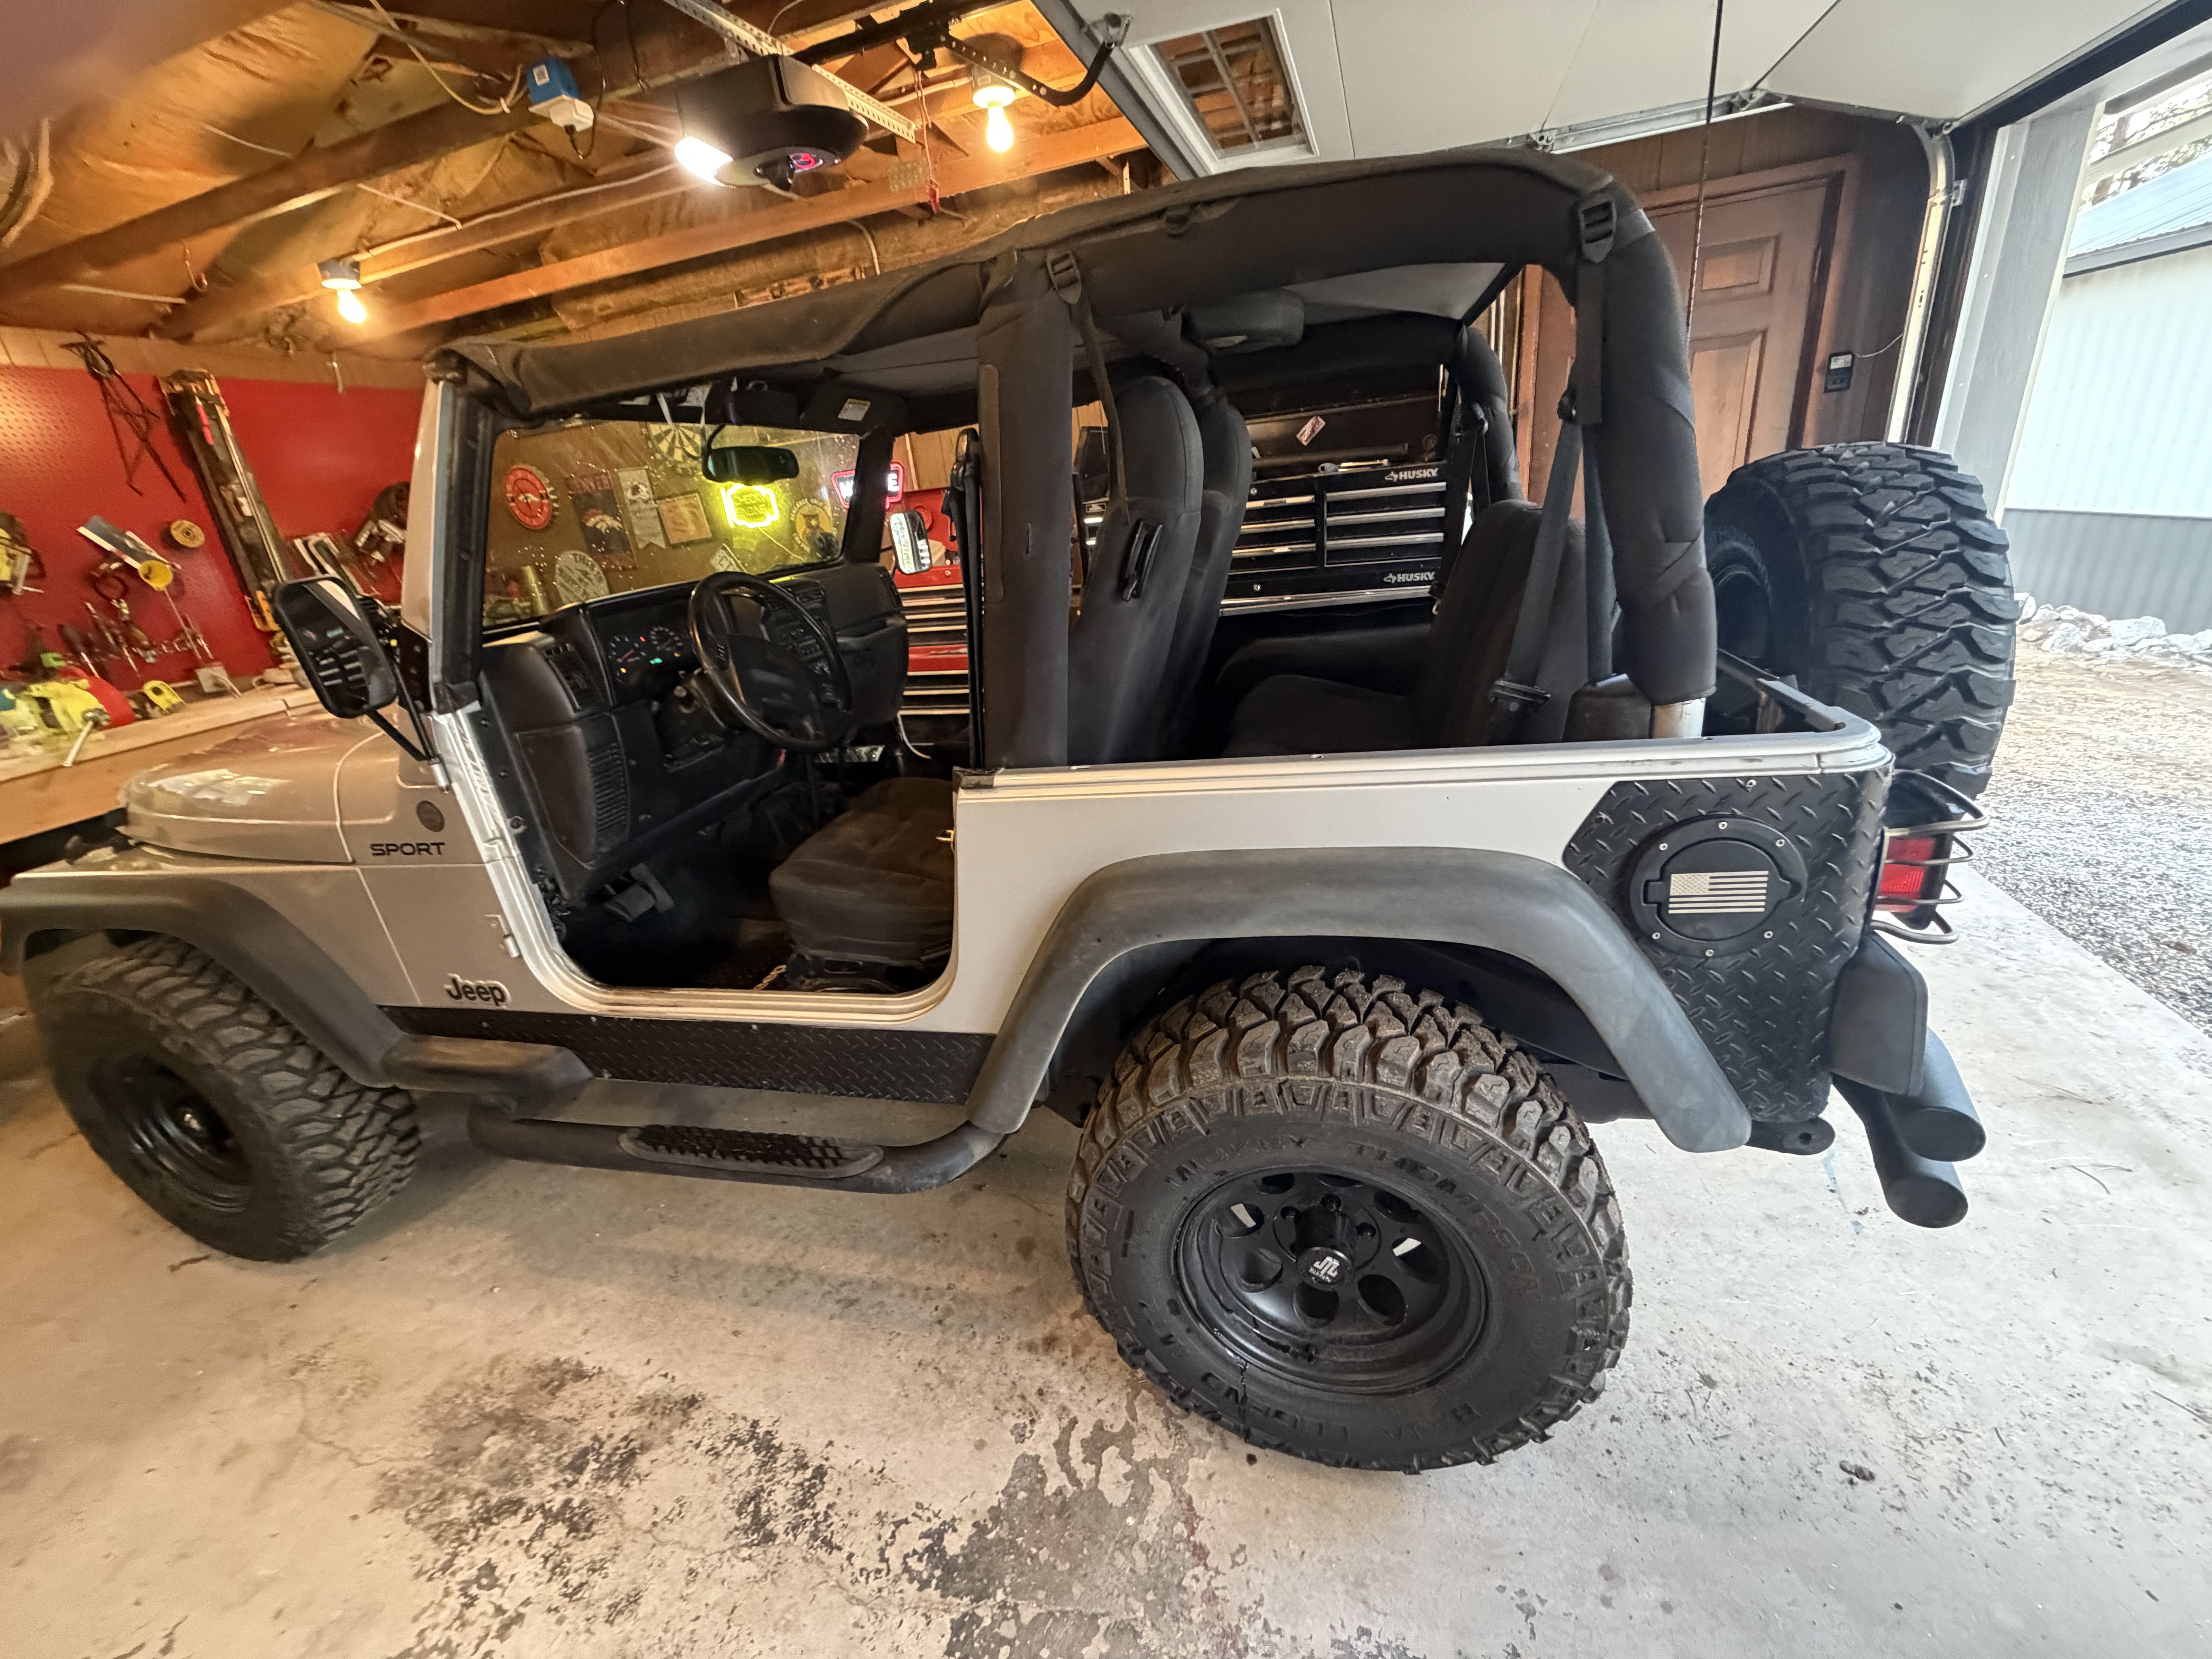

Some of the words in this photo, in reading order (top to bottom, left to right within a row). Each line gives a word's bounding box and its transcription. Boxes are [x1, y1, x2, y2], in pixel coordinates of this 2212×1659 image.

[1399, 468, 1439, 480] HUSKY
[734, 492, 764, 505] CHECK
[737, 504, 767, 517] ENGINE
[1397, 571, 1436, 582] HUSKY
[371, 842, 445, 856] SPORT
[446, 978, 506, 1006] Jeep
